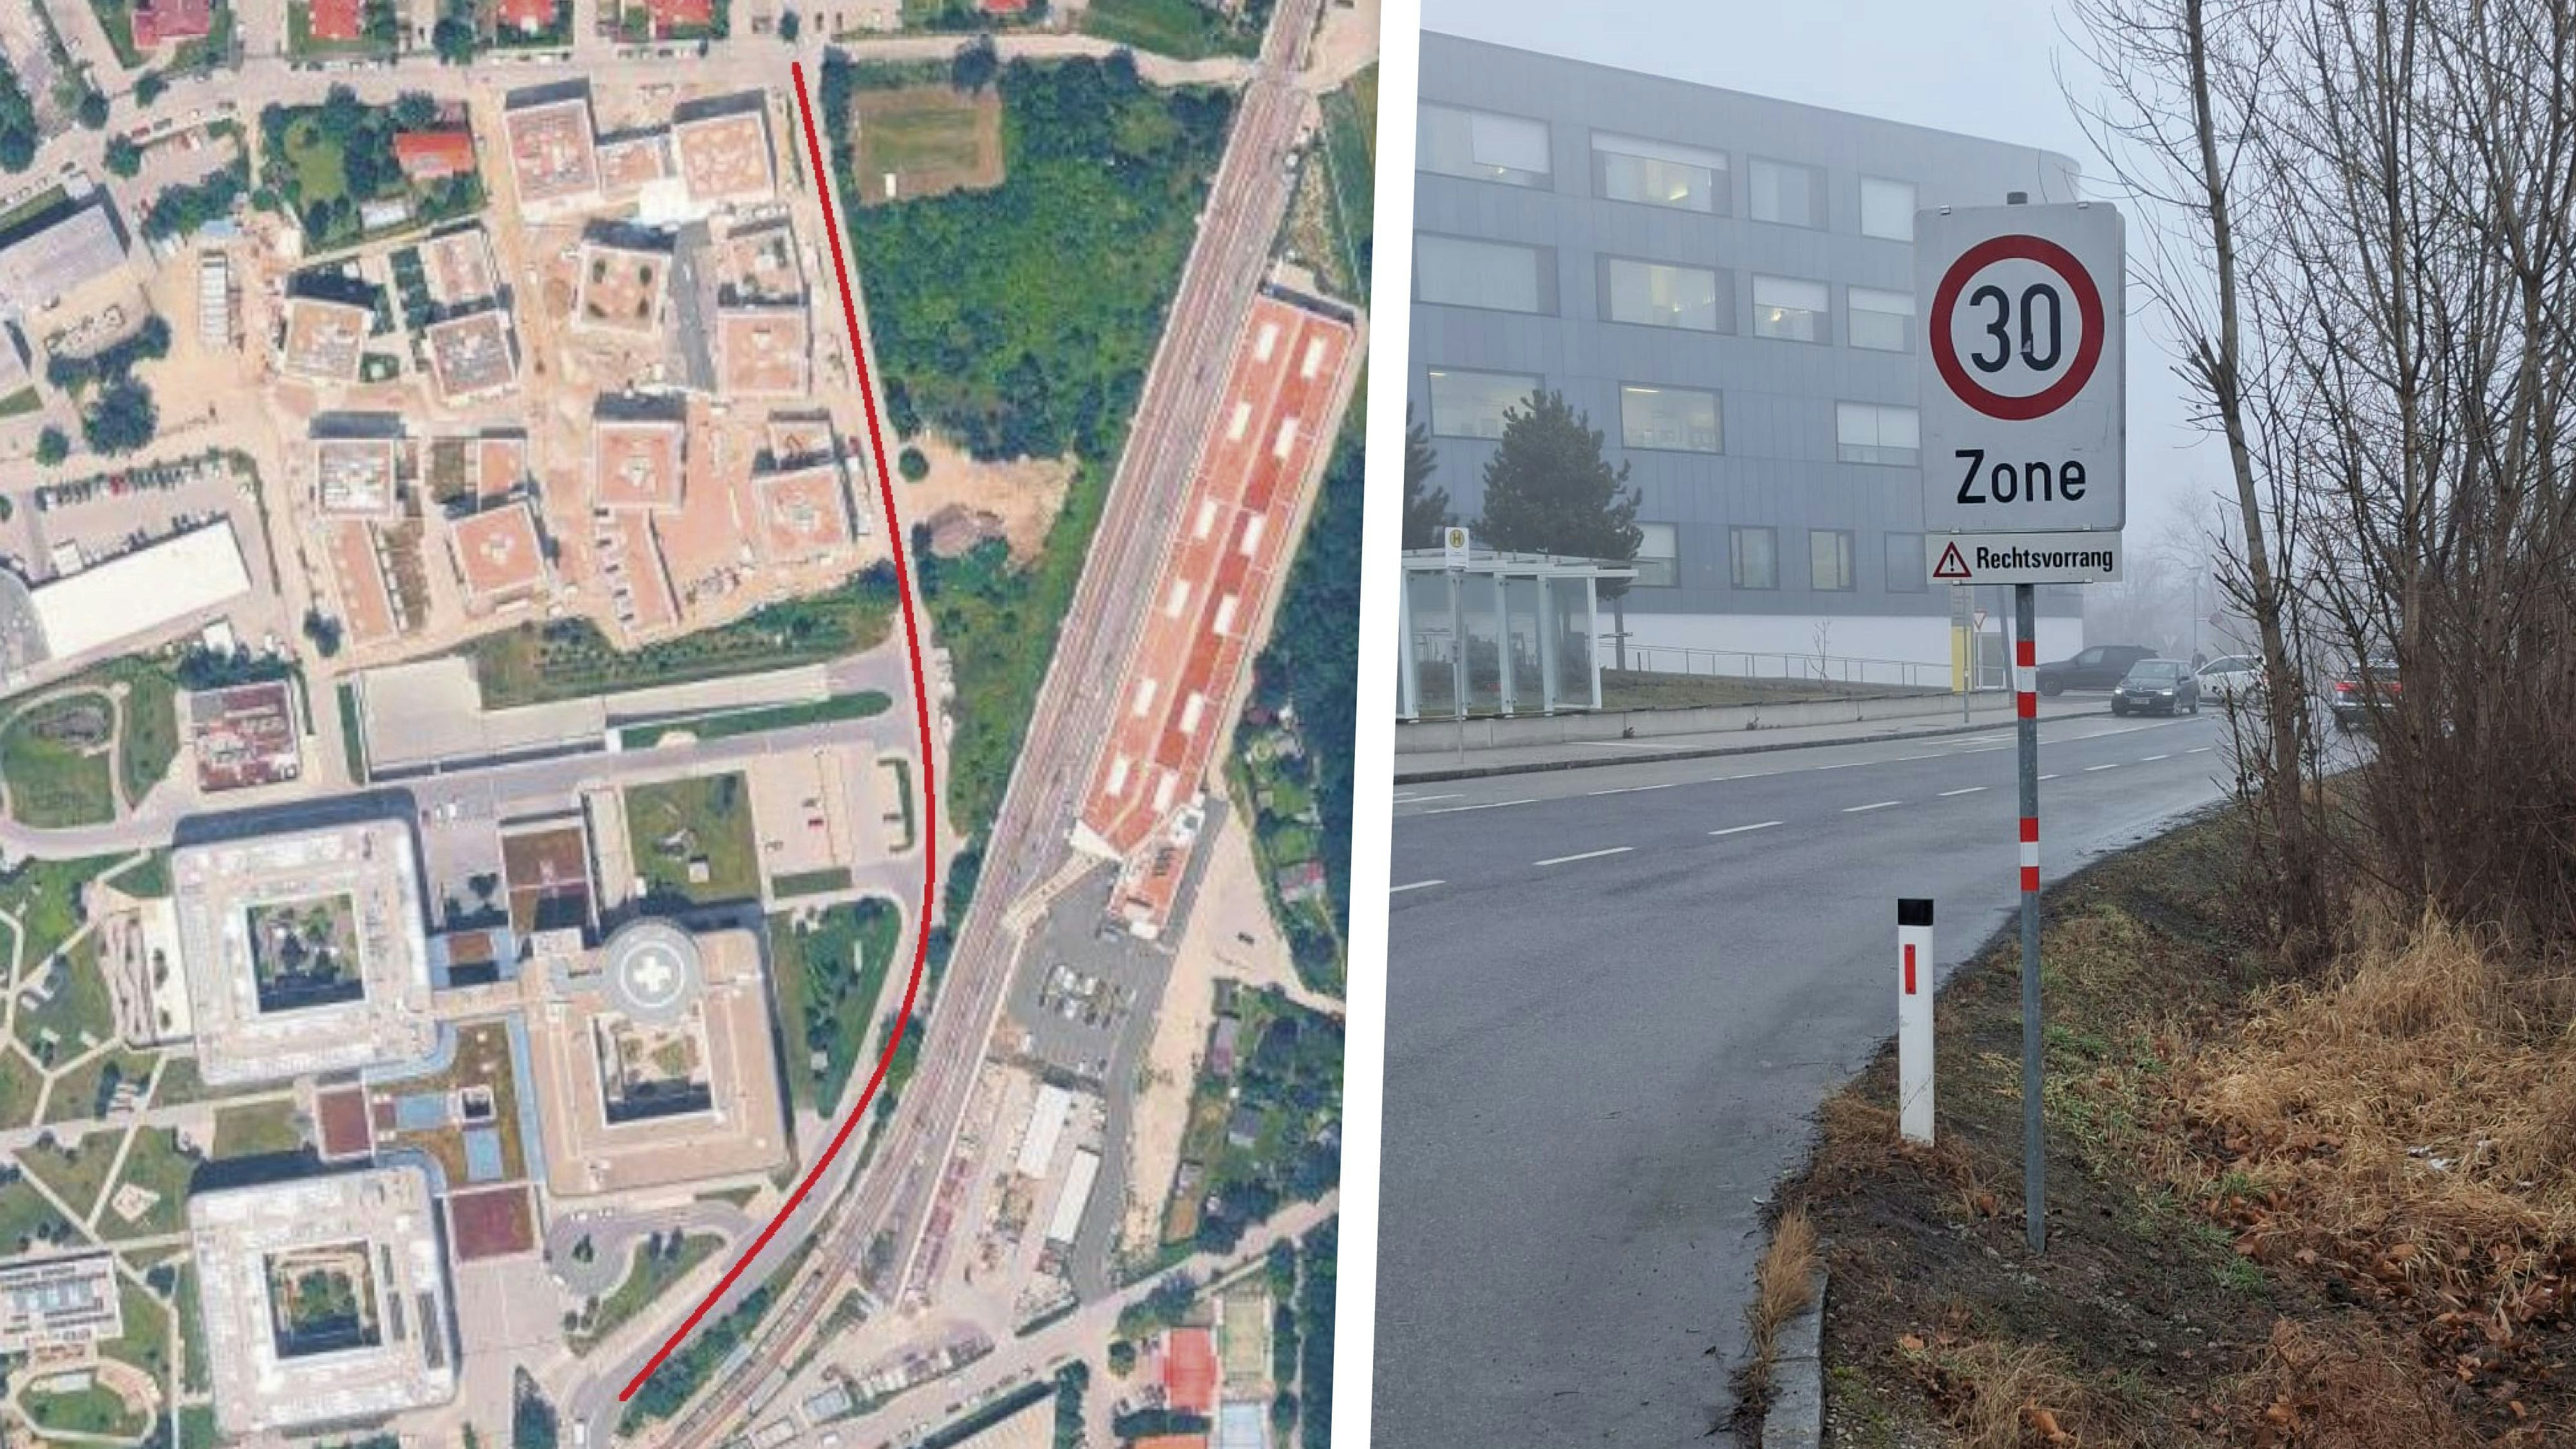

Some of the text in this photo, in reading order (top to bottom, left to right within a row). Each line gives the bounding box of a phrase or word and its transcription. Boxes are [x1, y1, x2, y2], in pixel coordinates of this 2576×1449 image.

[1969, 283, 2061, 373] 30
[1955, 449, 2087, 504] Zone
[1975, 545, 2114, 573] Rechtsvorrang
